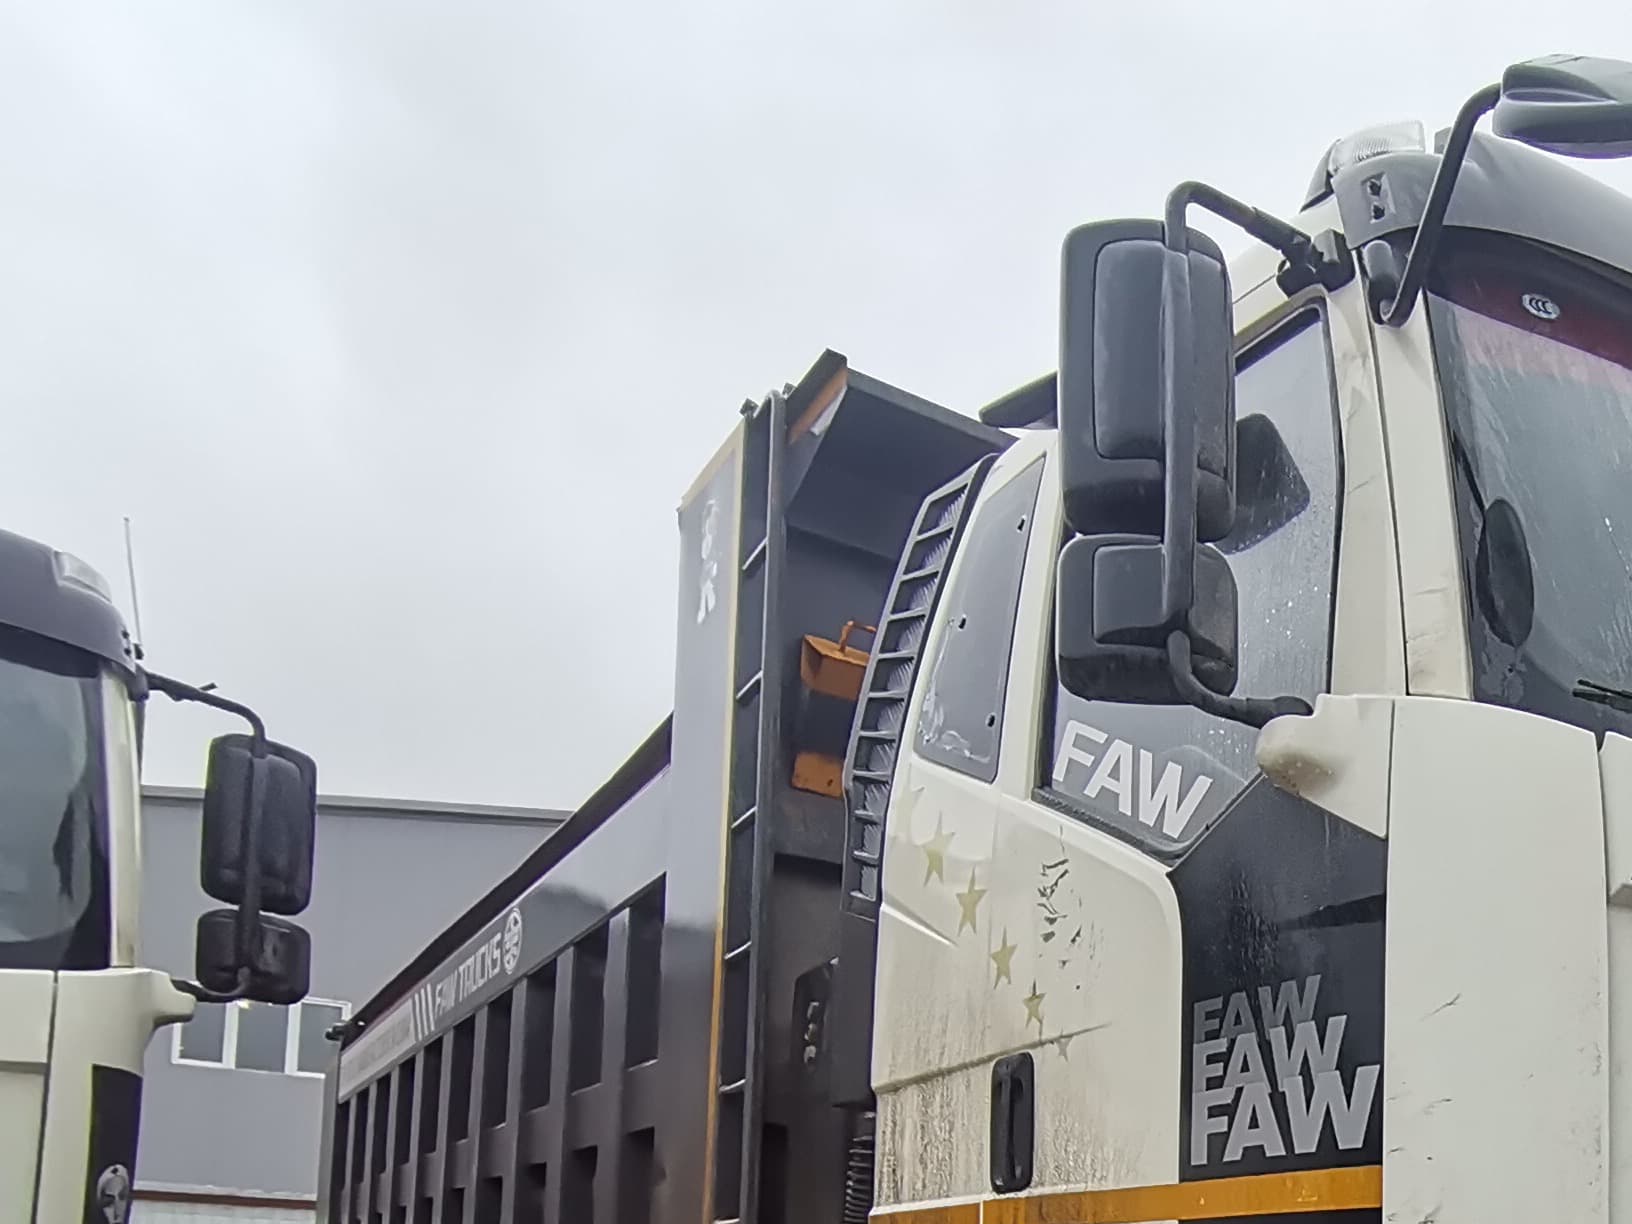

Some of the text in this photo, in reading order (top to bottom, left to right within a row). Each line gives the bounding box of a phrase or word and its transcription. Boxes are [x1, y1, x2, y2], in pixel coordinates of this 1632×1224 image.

[1052, 719, 1213, 838] FAW
[458, 932, 502, 1003] TRUCKS
[1192, 974, 1322, 1046] FAW
[1192, 1015, 1348, 1094] FAW
[1190, 1064, 1380, 1165] FAW
